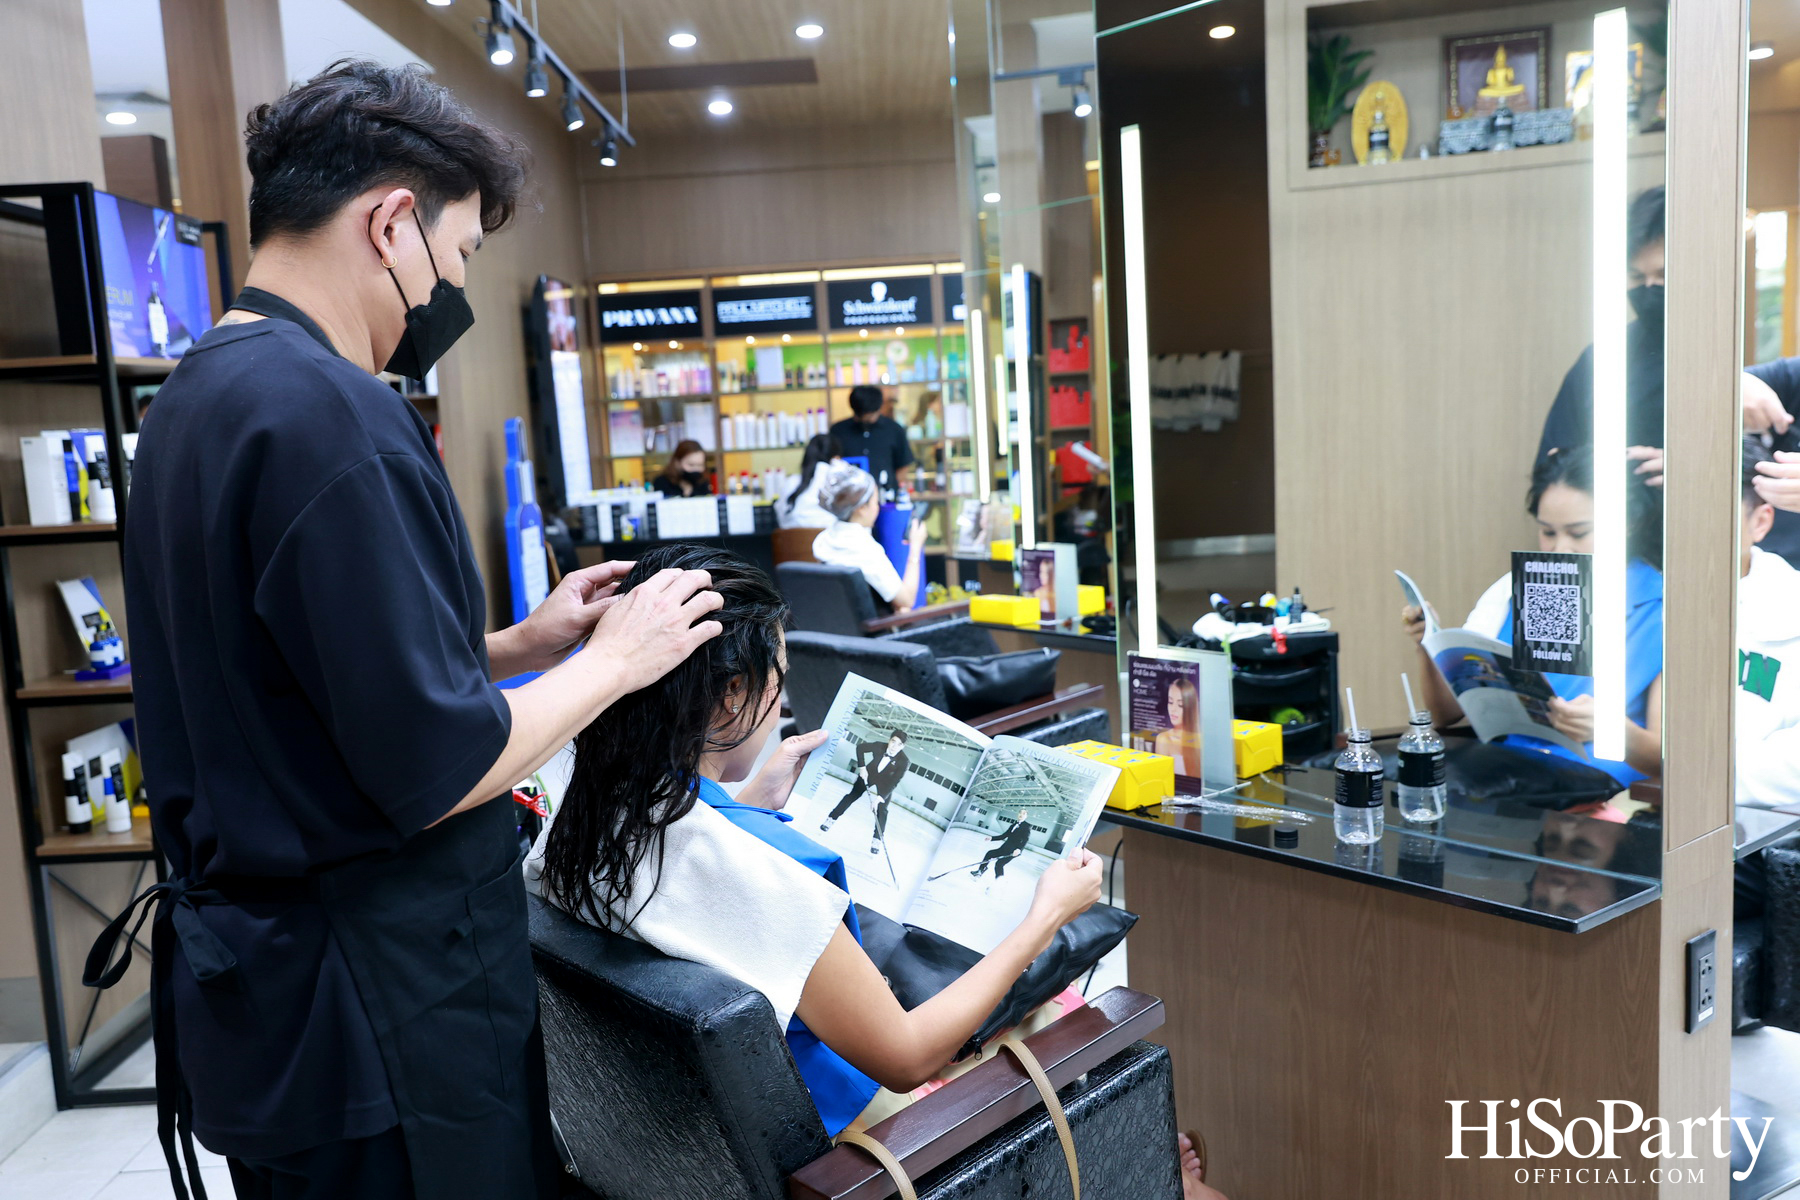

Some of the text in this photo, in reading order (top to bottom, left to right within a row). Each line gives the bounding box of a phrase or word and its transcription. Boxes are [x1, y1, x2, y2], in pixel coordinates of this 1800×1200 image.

[1524, 561, 1579, 575] CHALACHOL
[1532, 650, 1572, 662] FOLLOW US
